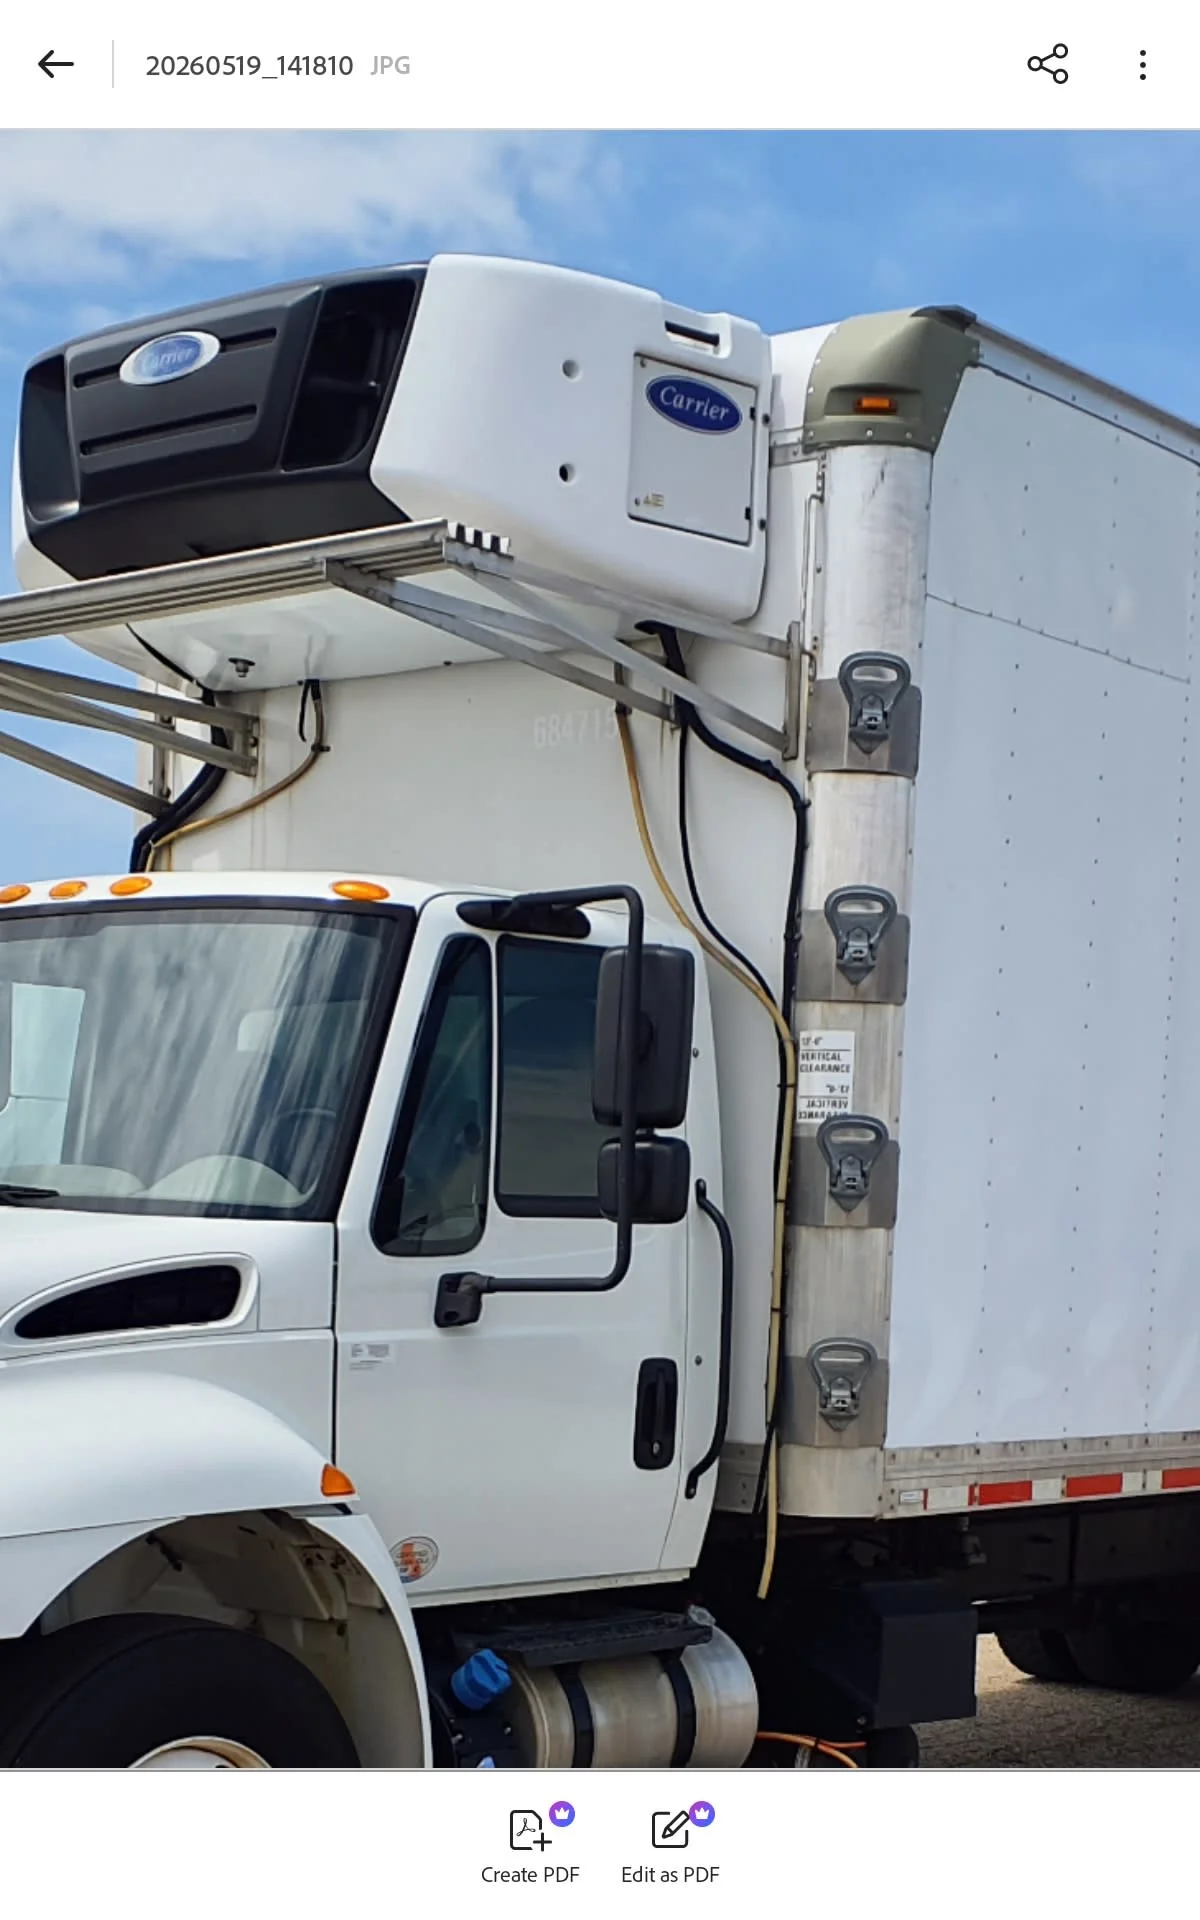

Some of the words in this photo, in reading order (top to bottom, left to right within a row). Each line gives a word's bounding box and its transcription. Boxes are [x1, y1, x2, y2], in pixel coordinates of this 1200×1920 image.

[659, 385, 730, 422] Carrier
[800, 1051, 842, 1062] VERTICAL
[799, 1063, 851, 1073] CLEARANCE
